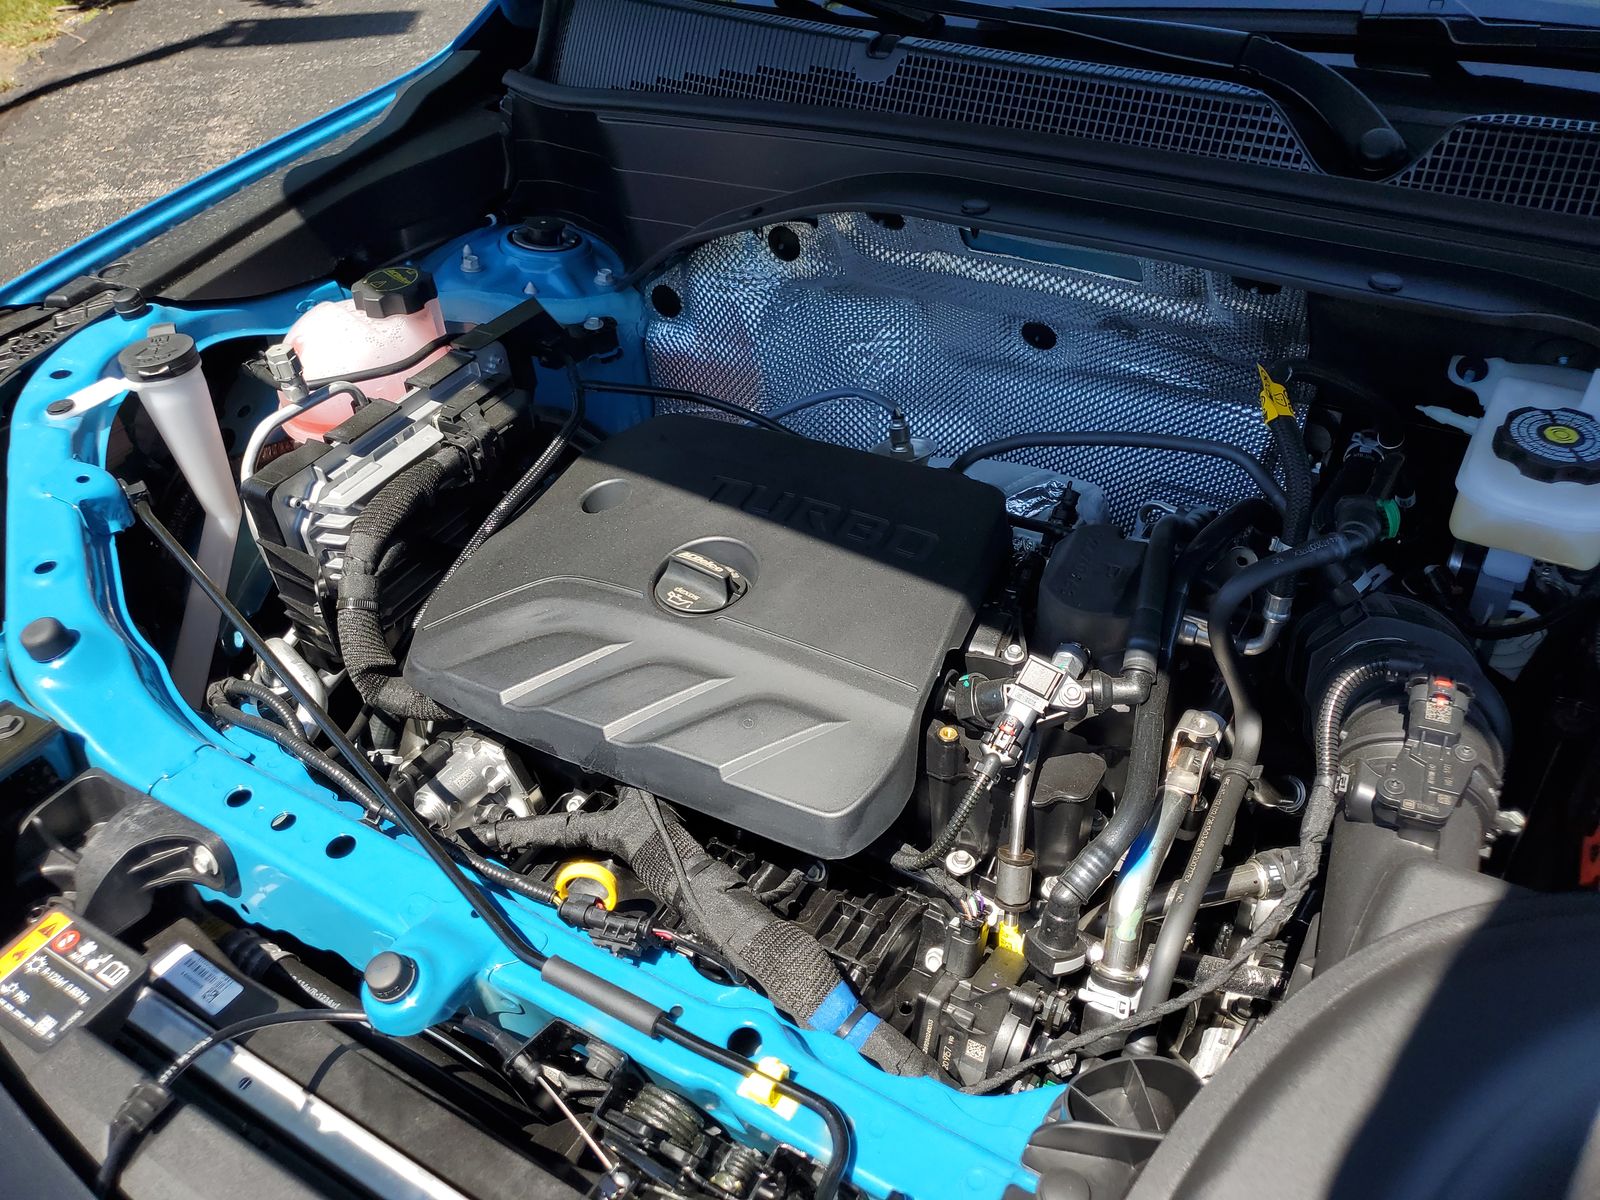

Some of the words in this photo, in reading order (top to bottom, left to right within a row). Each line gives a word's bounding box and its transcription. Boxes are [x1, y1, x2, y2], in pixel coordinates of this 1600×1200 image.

[708, 474, 941, 563] TURBO
[676, 551, 724, 572] ACDelco
[674, 586, 701, 601] dexos
